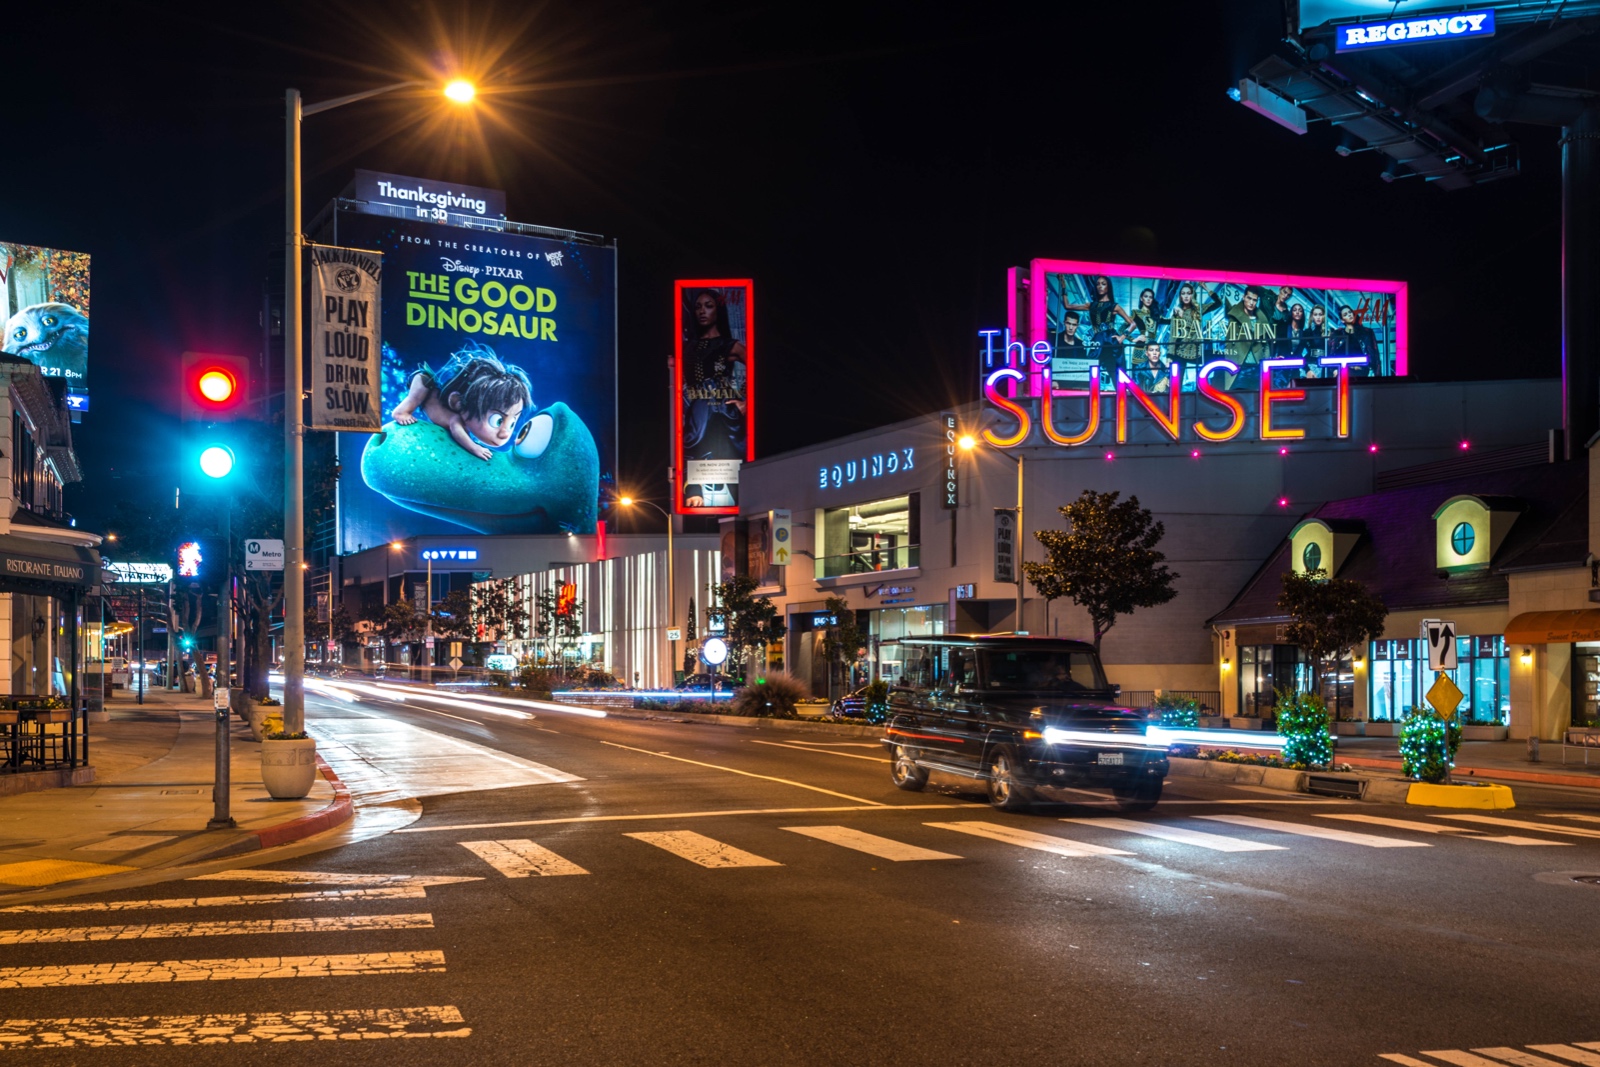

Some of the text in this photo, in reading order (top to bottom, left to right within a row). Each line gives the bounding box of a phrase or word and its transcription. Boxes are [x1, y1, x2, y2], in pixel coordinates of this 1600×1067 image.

[1346, 14, 1487, 45] REGENCY
[378, 181, 486, 214] Thanksgiving
[416, 205, 448, 220] in 3D
[400, 235, 540, 260] FROM THE CREATORS OF
[485, 265, 524, 280] PIXAR
[406, 271, 557, 313] THE GOOD
[325, 295, 369, 328] PLAY
[406, 302, 558, 342] DINOSAUR
[1172, 318, 1278, 341] BALMAIN
[325, 331, 370, 362] LOUD
[978, 327, 1052, 367] The
[50, 367, 61, 376] 21
[325, 364, 369, 386] DRINK
[325, 387, 370, 414] SLOW
[687, 387, 743, 400] BALMAIN
[981, 356, 1369, 449] SUNSET
[819, 447, 914, 488] EQUINOX
[946, 417, 957, 504] EQUINOX
[6, 558, 84, 579] RISTORANTE ITALIANO
[670, 631, 680, 639] 25
[1547, 632, 1569, 641] Sunset
